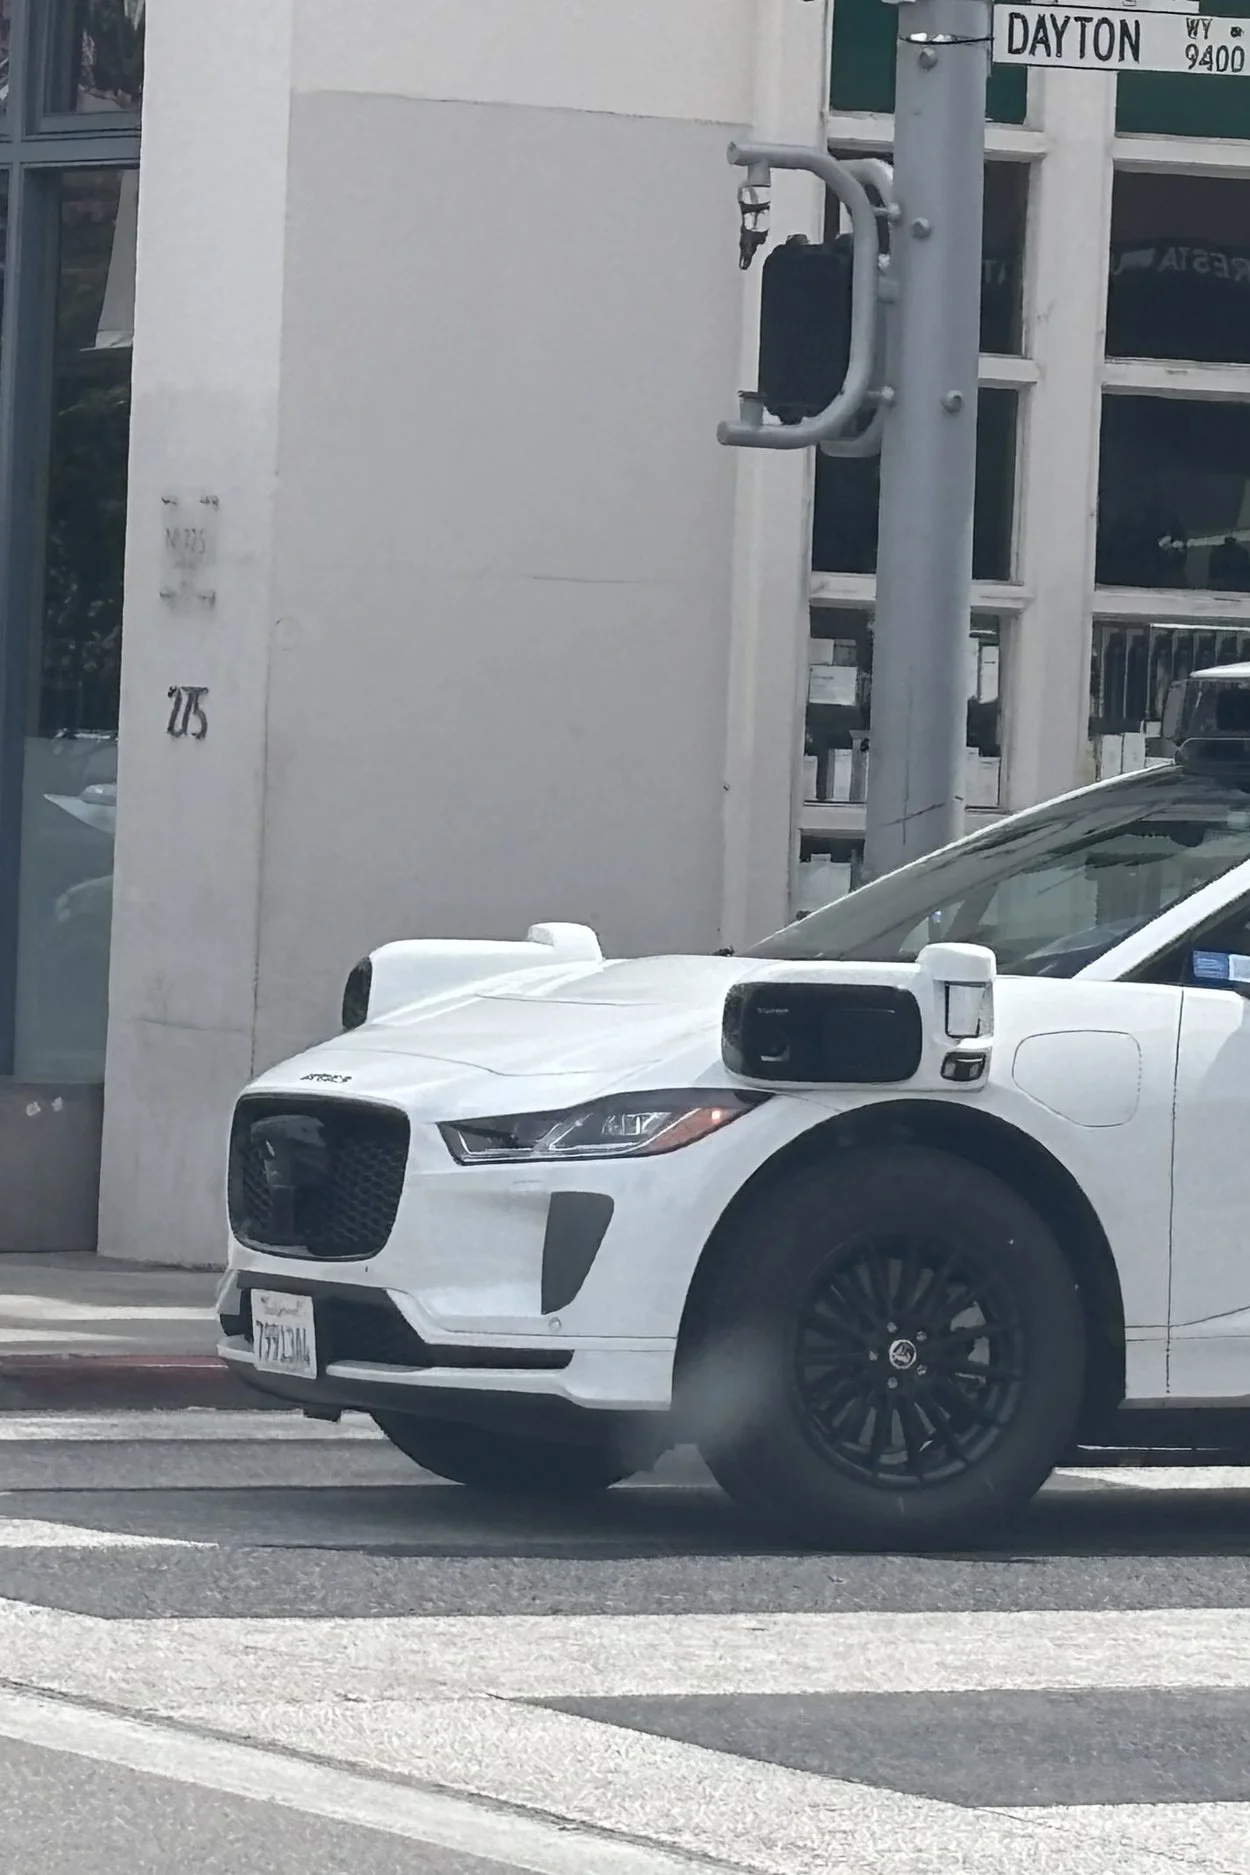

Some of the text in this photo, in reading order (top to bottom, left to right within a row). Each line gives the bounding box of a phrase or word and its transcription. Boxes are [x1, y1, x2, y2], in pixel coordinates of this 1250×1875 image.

[1007, 12, 1211, 63] DAYTON WY
[1185, 43, 1245, 73] 9400
